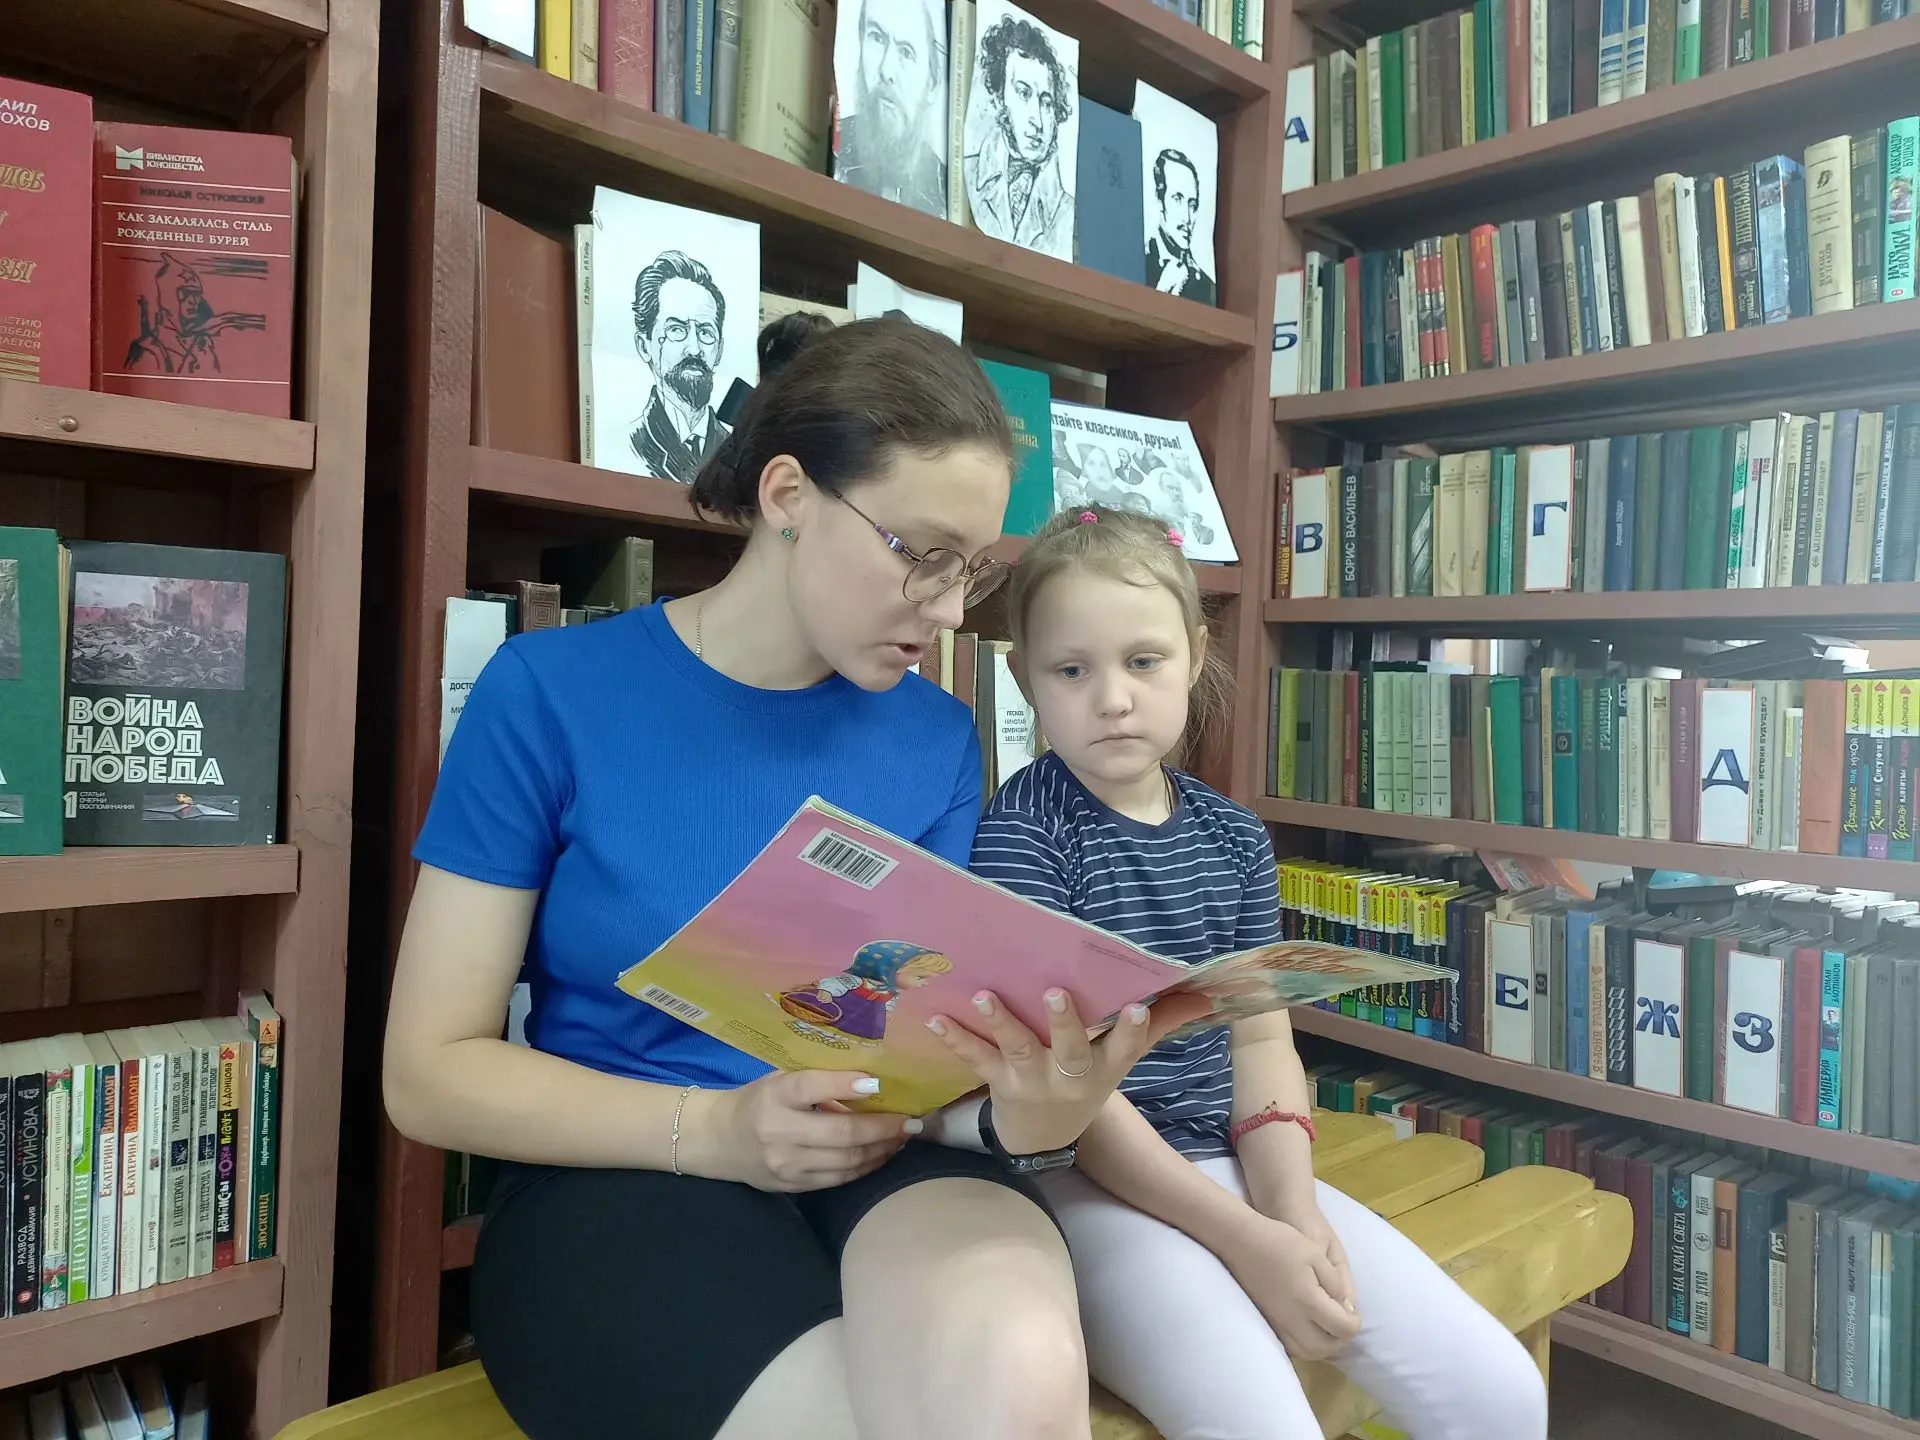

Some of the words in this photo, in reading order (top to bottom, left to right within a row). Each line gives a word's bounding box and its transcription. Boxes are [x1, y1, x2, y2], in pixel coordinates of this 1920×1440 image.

[0, 98, 37, 115] АИЛ
[0, 111, 50, 131] ОХОВ
[1285, 116, 1309, 143] А
[146, 152, 203, 164] БИБЛИОТЕКА
[146, 160, 205, 172] ЮНОШЕСТВА
[1889, 134, 1902, 175] АЛЕКСАНДР
[1902, 136, 1914, 166] БУШКОВ
[117, 227, 204, 243] РОЖДЕННЫЕ
[209, 232, 250, 246] БУРЕЙ
[118, 211, 144, 223] КАК
[148, 213, 229, 229] ЗАКАЛЯЛАСЬ
[233, 219, 273, 232] СТАЛЬ
[1272, 320, 1298, 352] Б
[1085, 420, 1144, 446] классиков,
[1144, 432, 1182, 450] друзья!
[1752, 458, 1760, 481] ОДИН
[1763, 458, 1771, 473] ГОД
[1346, 475, 1357, 538] ВАСИЛЬЕВ
[1533, 501, 1568, 537] Г
[1295, 522, 1323, 554] В
[1281, 547, 1290, 585] БУШКОВ
[1345, 543, 1355, 581] БОРИС
[68, 693, 204, 728] ВОЙНА
[66, 725, 203, 756] НАРОД
[64, 754, 225, 786] ПОБЕДА
[1702, 749, 1749, 795] Д
[63, 791, 77, 818] 1
[1495, 972, 1529, 1011] Е
[1824, 970, 1832, 994] РОМАН
[1831, 963, 1841, 1003] ЗЛОТНИКОВ
[1635, 996, 1681, 1039] Ж
[1732, 1011, 1775, 1054] З
[1818, 1060, 1835, 1107] ИМПЕРИЯ
[101, 1074, 115, 1134] ВИЛЬМОНТ
[125, 1074, 138, 1133] ВИЛЬМОНТ
[22, 1106, 39, 1187] УСТИНОВА
[99, 1137, 113, 1198] ЕКАТЕРИНА
[124, 1135, 138, 1197] ЕКАТЕРИНА
[71, 1173, 89, 1284] ВИЛЬМОНТ
[258, 1193, 270, 1249] ЗЮСКИНД
[1674, 1212, 1686, 1243] СВЕТА
[18, 1225, 28, 1265] РАЗВОД
[1671, 1246, 1685, 1273] КРАЙ
[1673, 1277, 1685, 1292] НА
[1696, 1270, 1709, 1296] ДУХОВ
[1695, 1301, 1708, 1332] КАМЕНЬ
